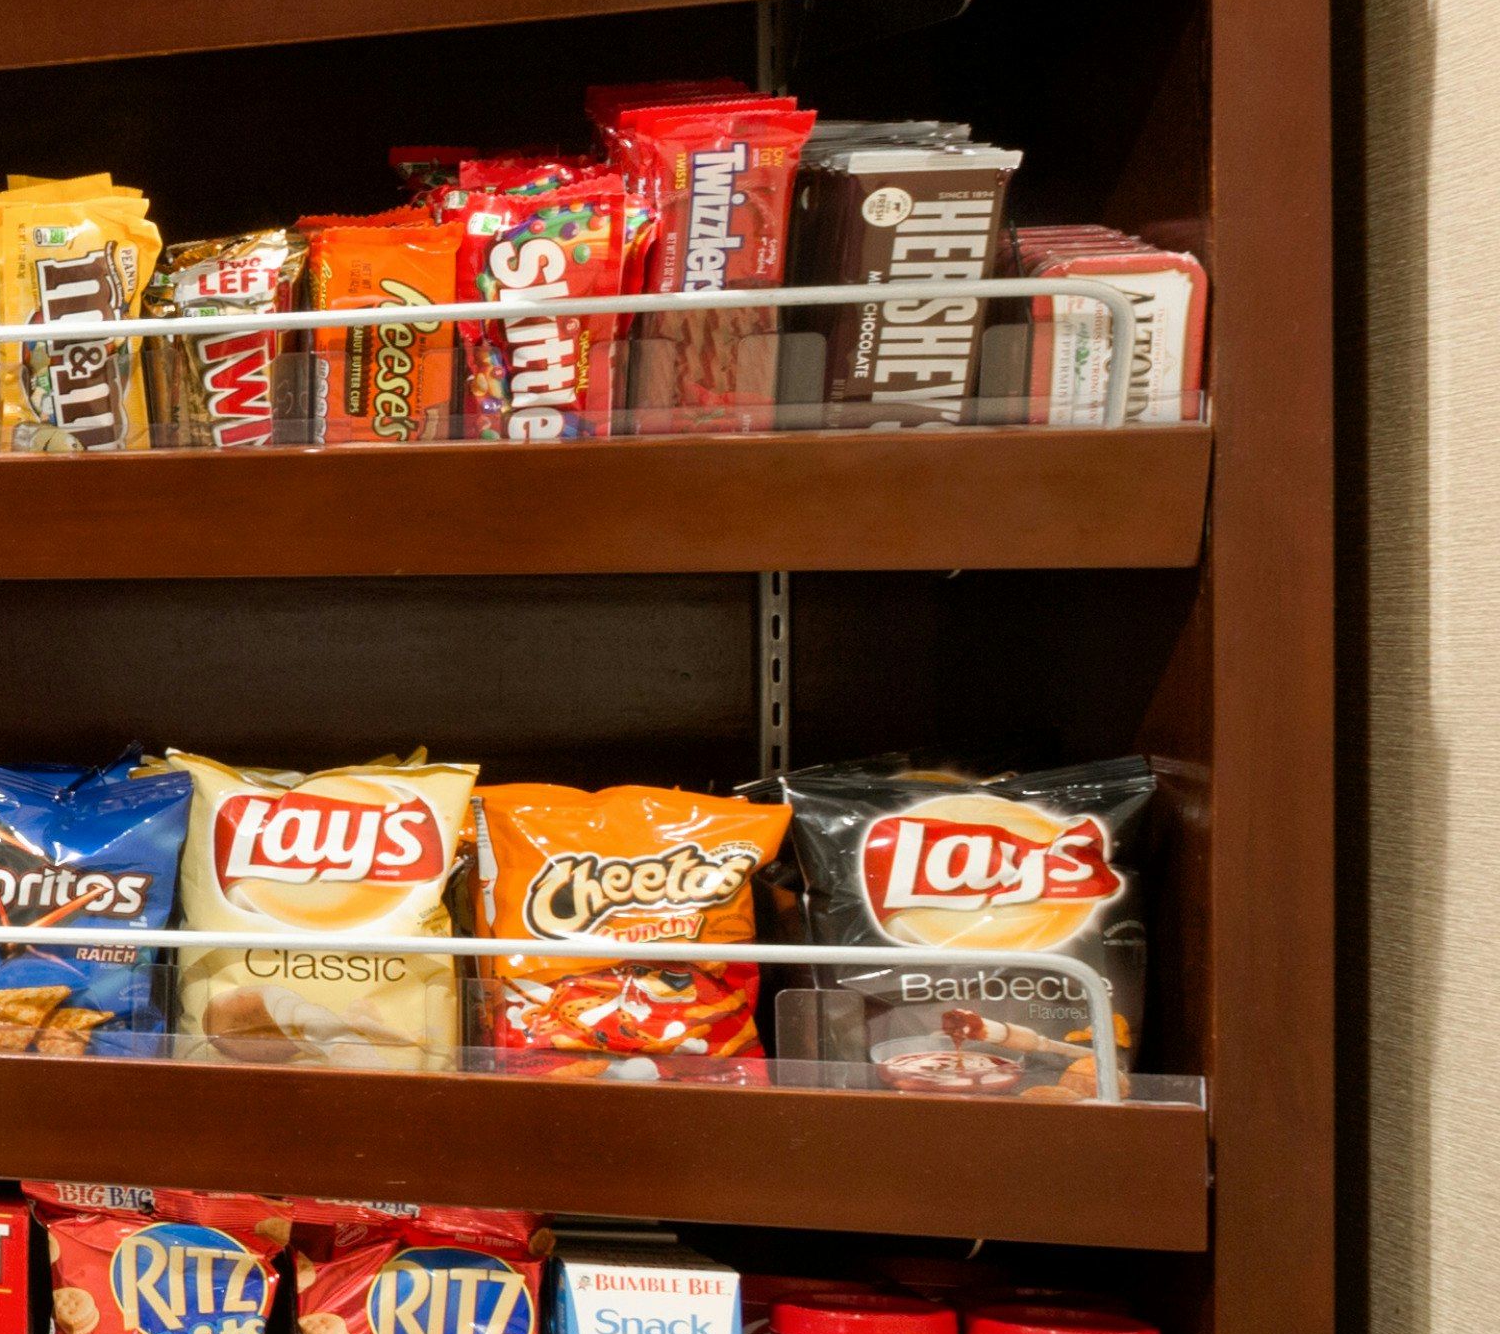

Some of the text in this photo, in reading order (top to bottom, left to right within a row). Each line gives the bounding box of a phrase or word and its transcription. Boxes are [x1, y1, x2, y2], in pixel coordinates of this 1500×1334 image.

[675, 152, 687, 190] TWISTS
[198, 267, 280, 296] LEFT
[217, 257, 262, 269] TWO
[490, 239, 577, 439] Skittle
[854, 303, 877, 379] CHOCOLATE
[869, 199, 995, 430] HERSHEY'
[350, 355, 362, 414] BUTTER CUPS
[225, 799, 427, 883] Lay's
[883, 820, 1095, 912] Lay's
[526, 846, 755, 939] Cheetos
[76, 947, 136, 963] RANCH
[244, 948, 406, 982] Classic
[1029, 1004, 1088, 1019] Flavored
[121, 1235, 258, 1331] RITZ
[595, 1274, 726, 1295] BUMBLE BEE
